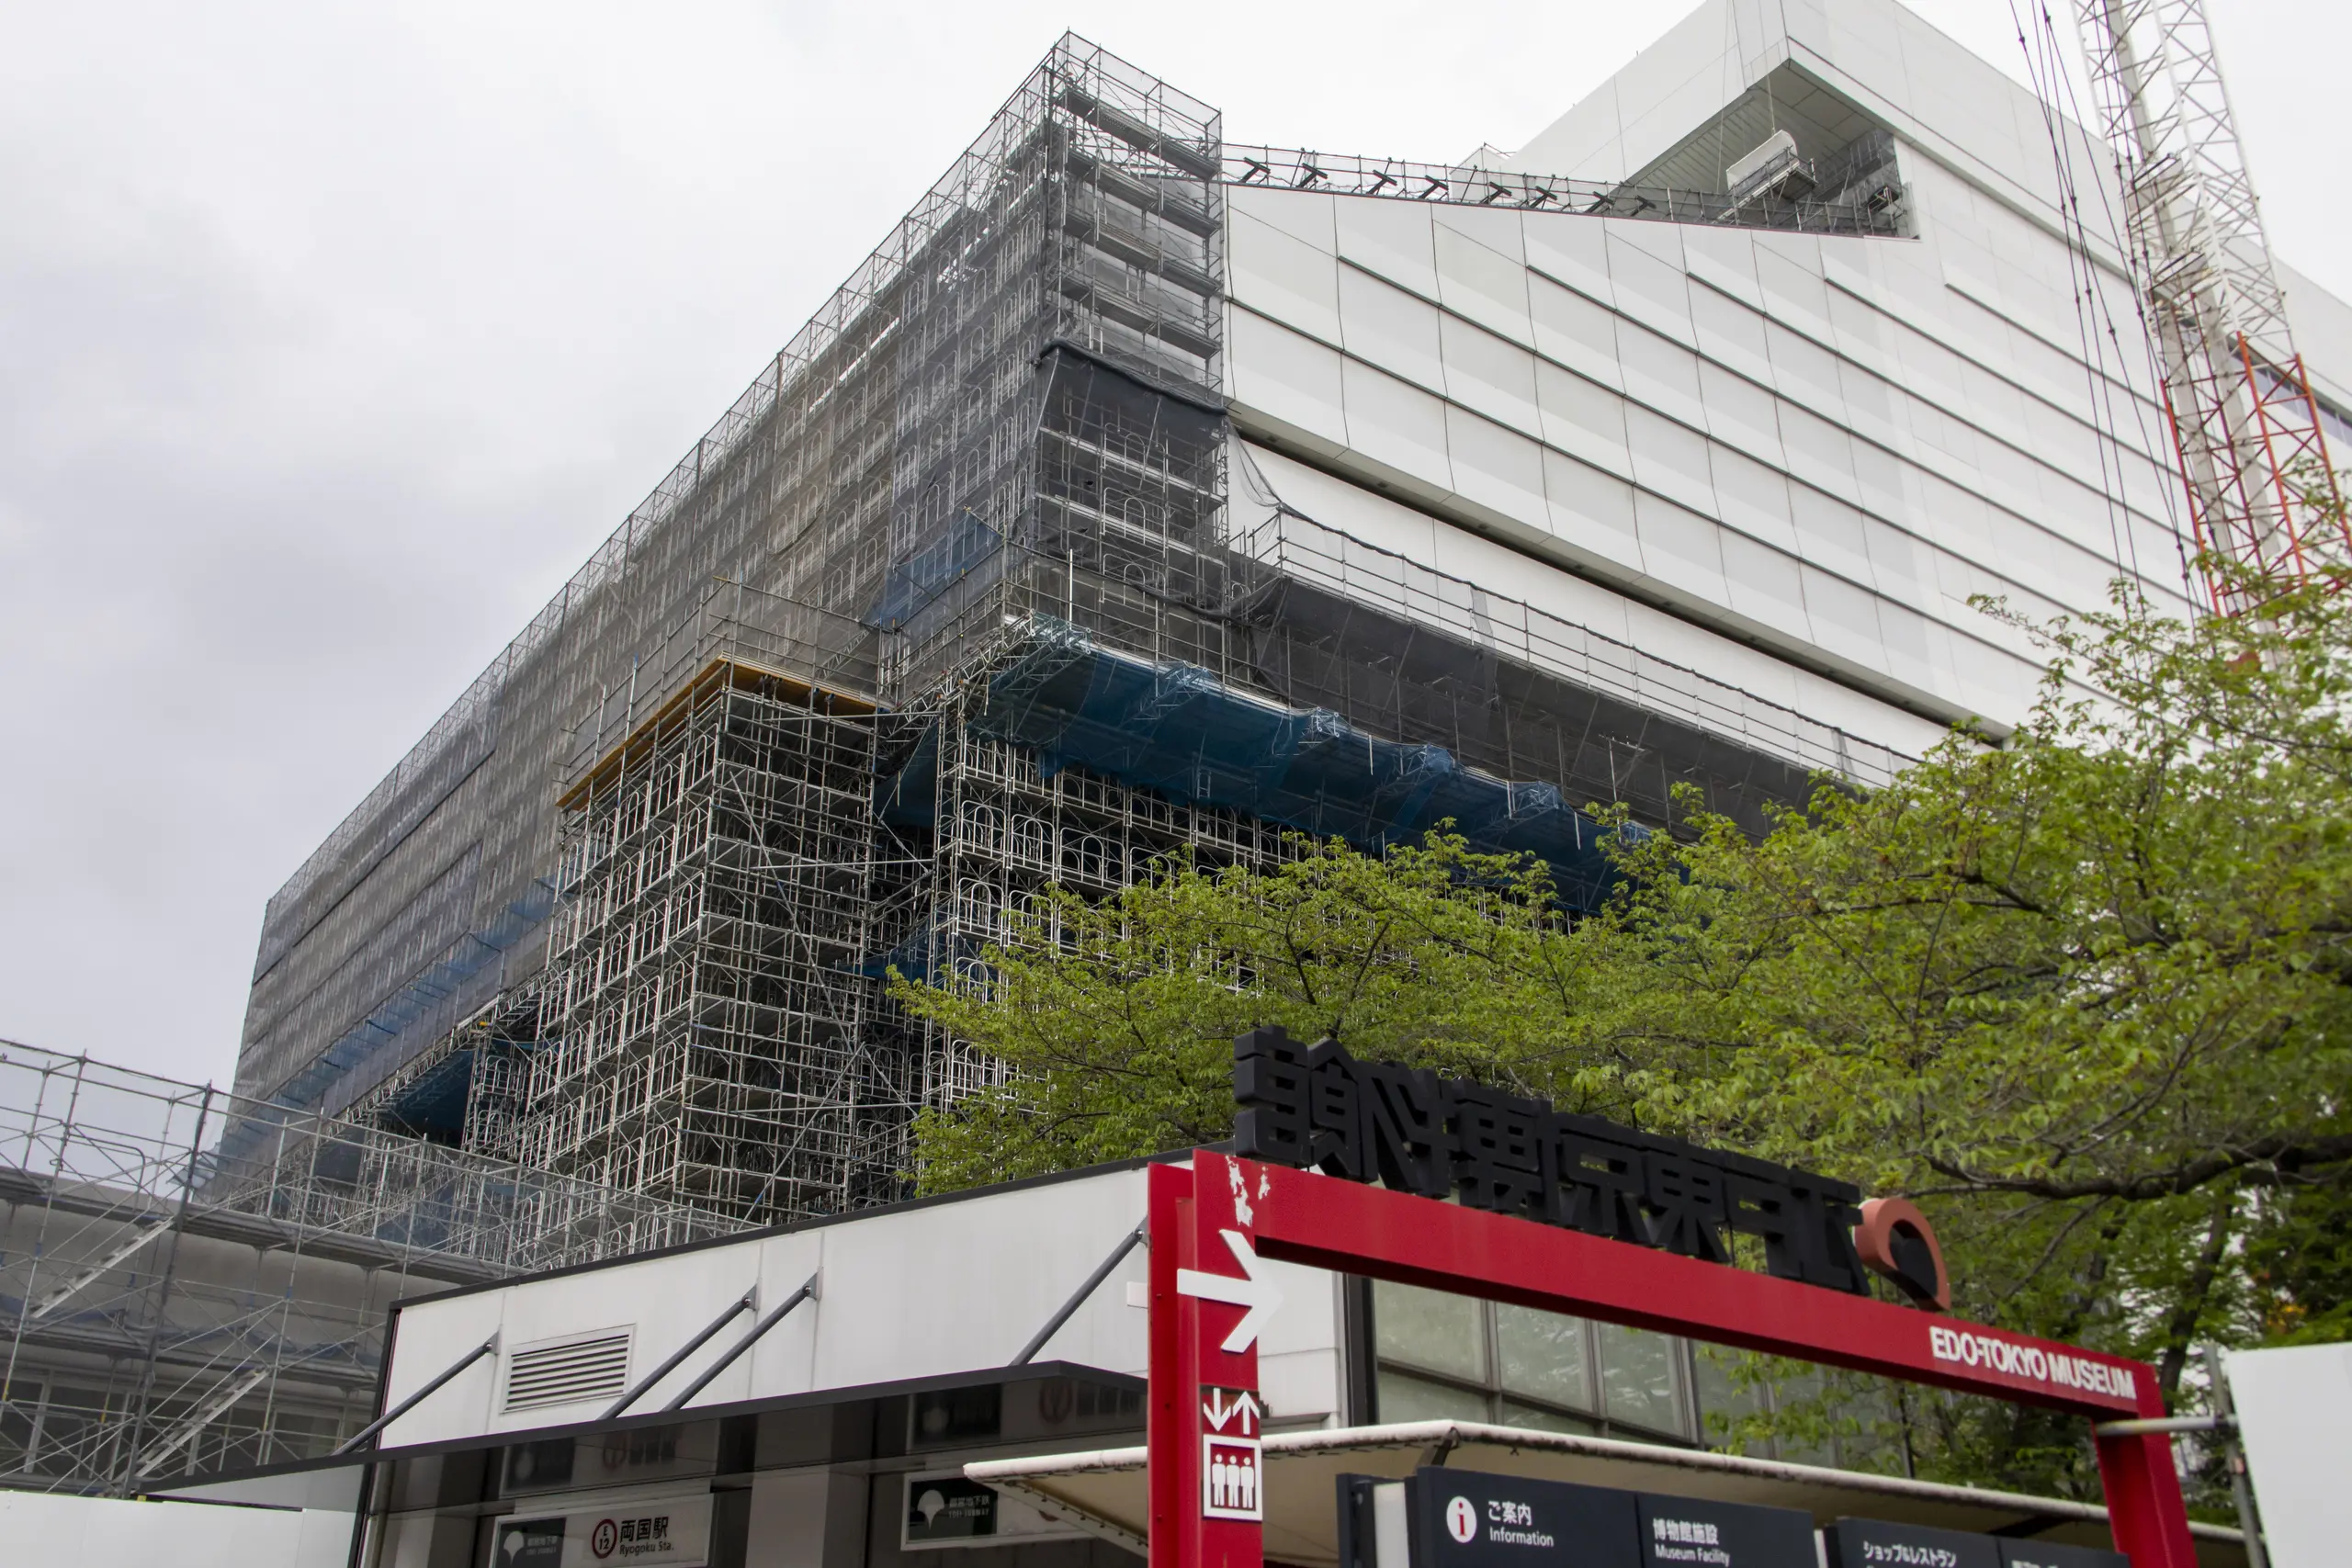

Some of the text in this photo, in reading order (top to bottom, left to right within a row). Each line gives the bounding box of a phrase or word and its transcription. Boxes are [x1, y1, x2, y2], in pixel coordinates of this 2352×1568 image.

[1929, 1325, 2138, 1401] EDO-TOKYO MUSEUM
[1488, 1500, 1532, 1527] ご案内
[603, 1526, 608, 1537] E
[619, 1517, 669, 1542] 両国駅
[1489, 1527, 1555, 1548] Information
[1653, 1517, 1719, 1546] 博物館施設
[599, 1538, 610, 1550] 12
[619, 1541, 674, 1558] Ryogoku Sta.
[1655, 1543, 1731, 1567] Museum Facility
